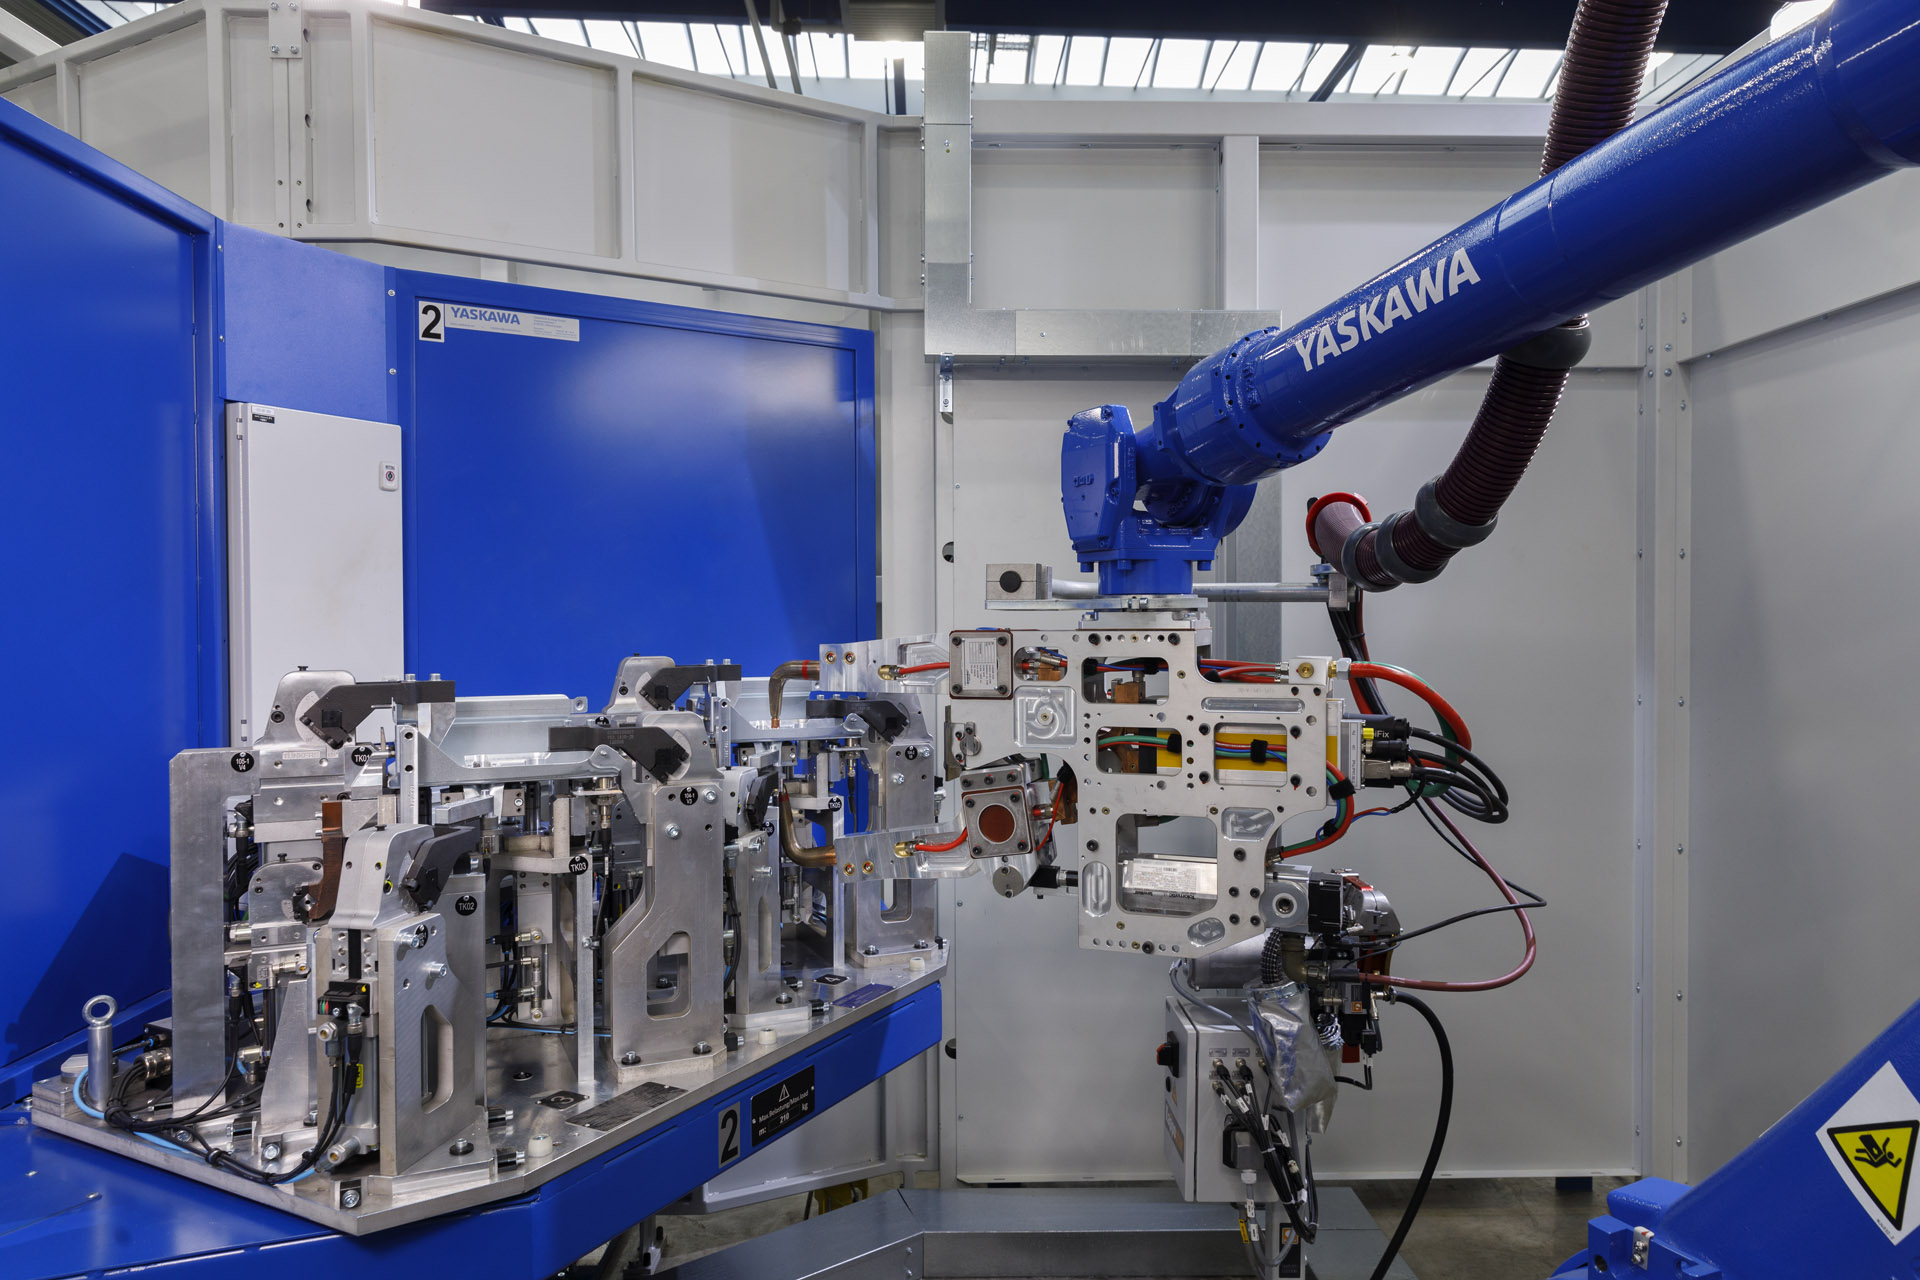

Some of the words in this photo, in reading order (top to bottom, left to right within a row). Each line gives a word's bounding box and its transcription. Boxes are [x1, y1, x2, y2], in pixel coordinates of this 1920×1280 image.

[1294, 247, 1481, 372] YASKAWA
[421, 304, 442, 340] 2
[450, 306, 521, 325] YASKAWA
[354, 753, 370, 763] TK01
[570, 862, 587, 872] TK03
[458, 902, 475, 911] TK02
[780, 1112, 790, 1123] 210
[802, 1102, 809, 1111] kg
[720, 1109, 738, 1164] 2
